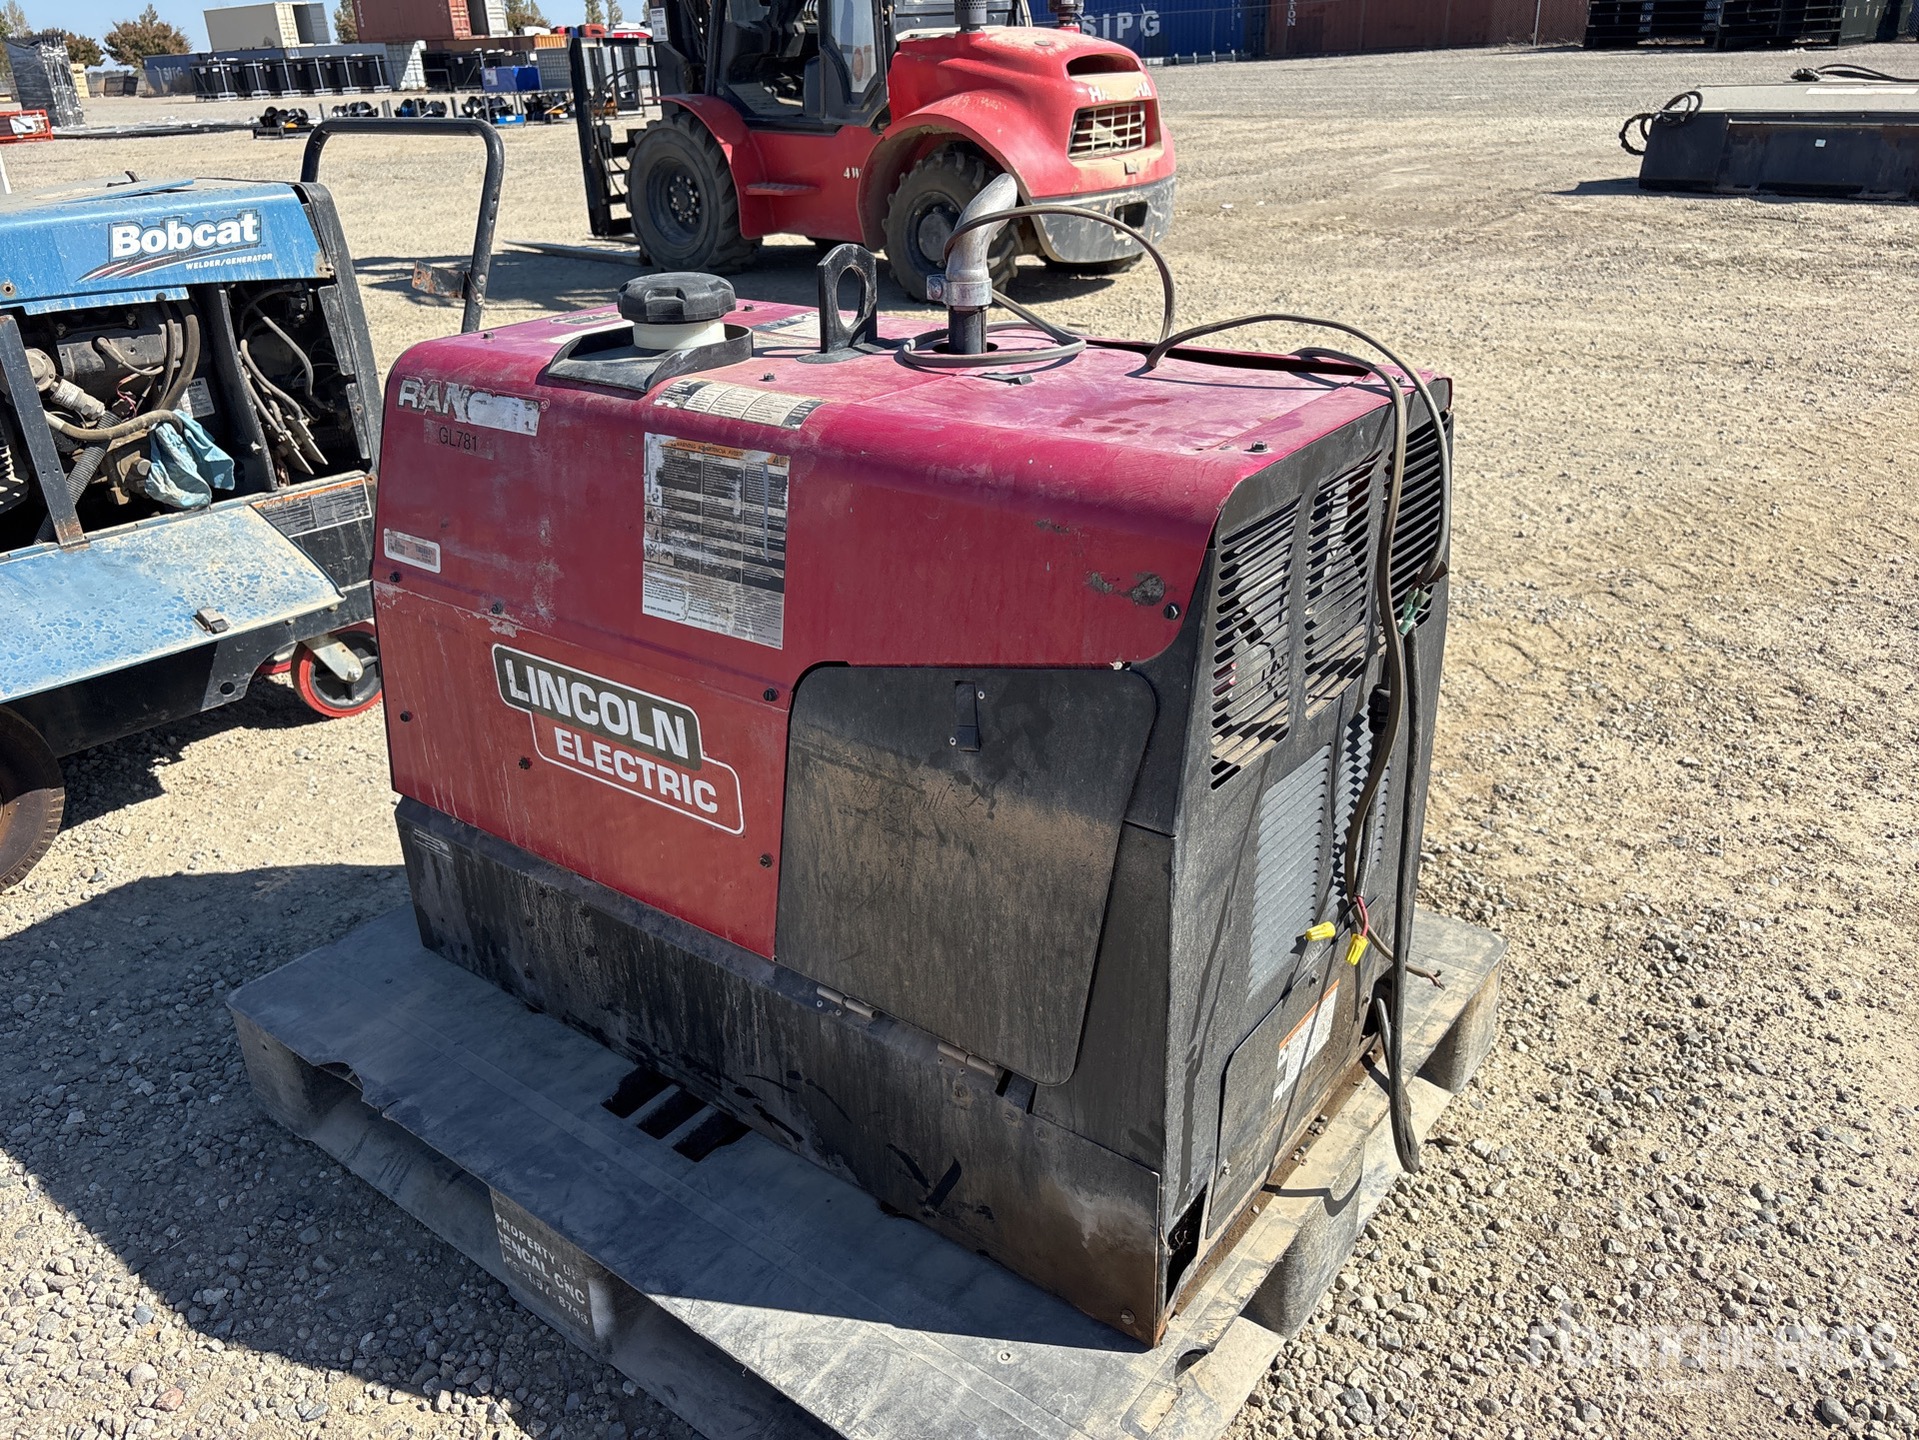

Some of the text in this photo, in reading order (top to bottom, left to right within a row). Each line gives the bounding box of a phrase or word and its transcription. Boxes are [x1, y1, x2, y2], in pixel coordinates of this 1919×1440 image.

[1081, 9, 1161, 41] SIPG
[111, 212, 259, 259] Bobcat
[186, 253, 273, 270] WELDER/GENERATOR
[438, 426, 478, 451] GL781
[504, 657, 689, 760] LINCOLN
[553, 726, 719, 814] ELECTRIC
[495, 1212, 555, 1265] PROPERTY
[554, 1272, 586, 1304] CNC
